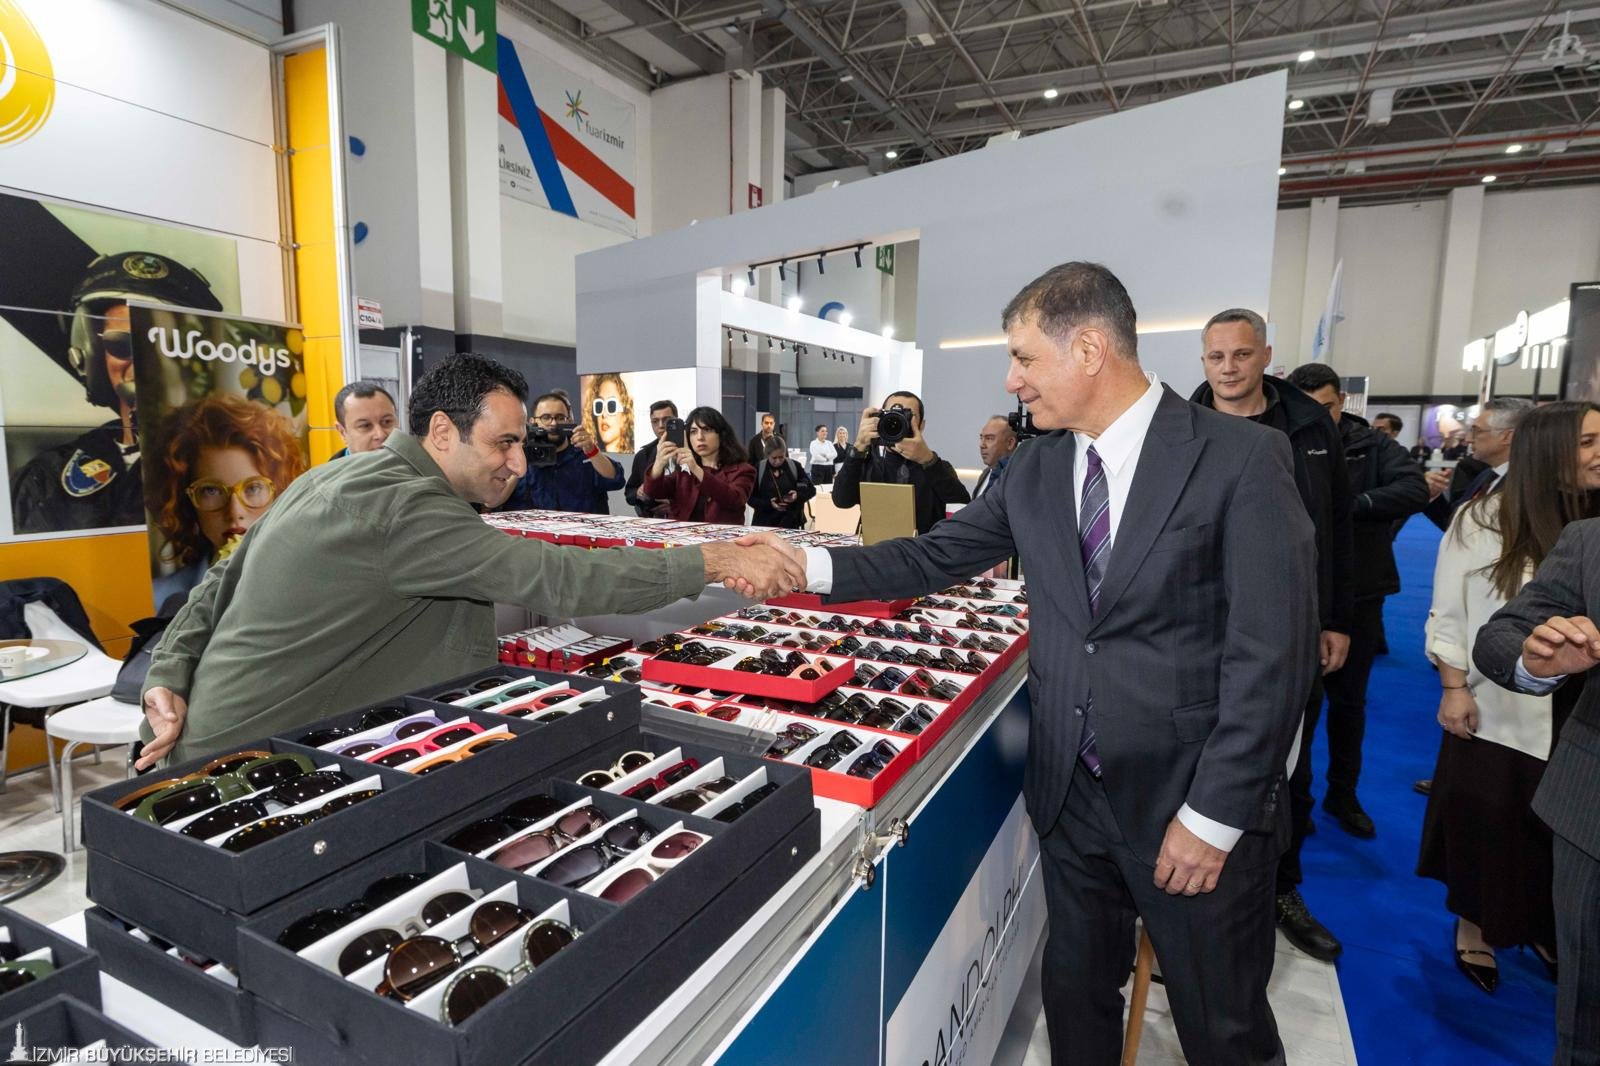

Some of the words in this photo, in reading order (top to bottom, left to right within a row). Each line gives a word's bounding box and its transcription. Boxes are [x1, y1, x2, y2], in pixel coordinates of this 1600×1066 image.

[585, 120, 625, 149] fuarizmir
[498, 157, 533, 180] LİRSİNİZ.
[148, 326, 291, 376] Woodys
[921, 865, 1022, 1066] ANDOLPH
